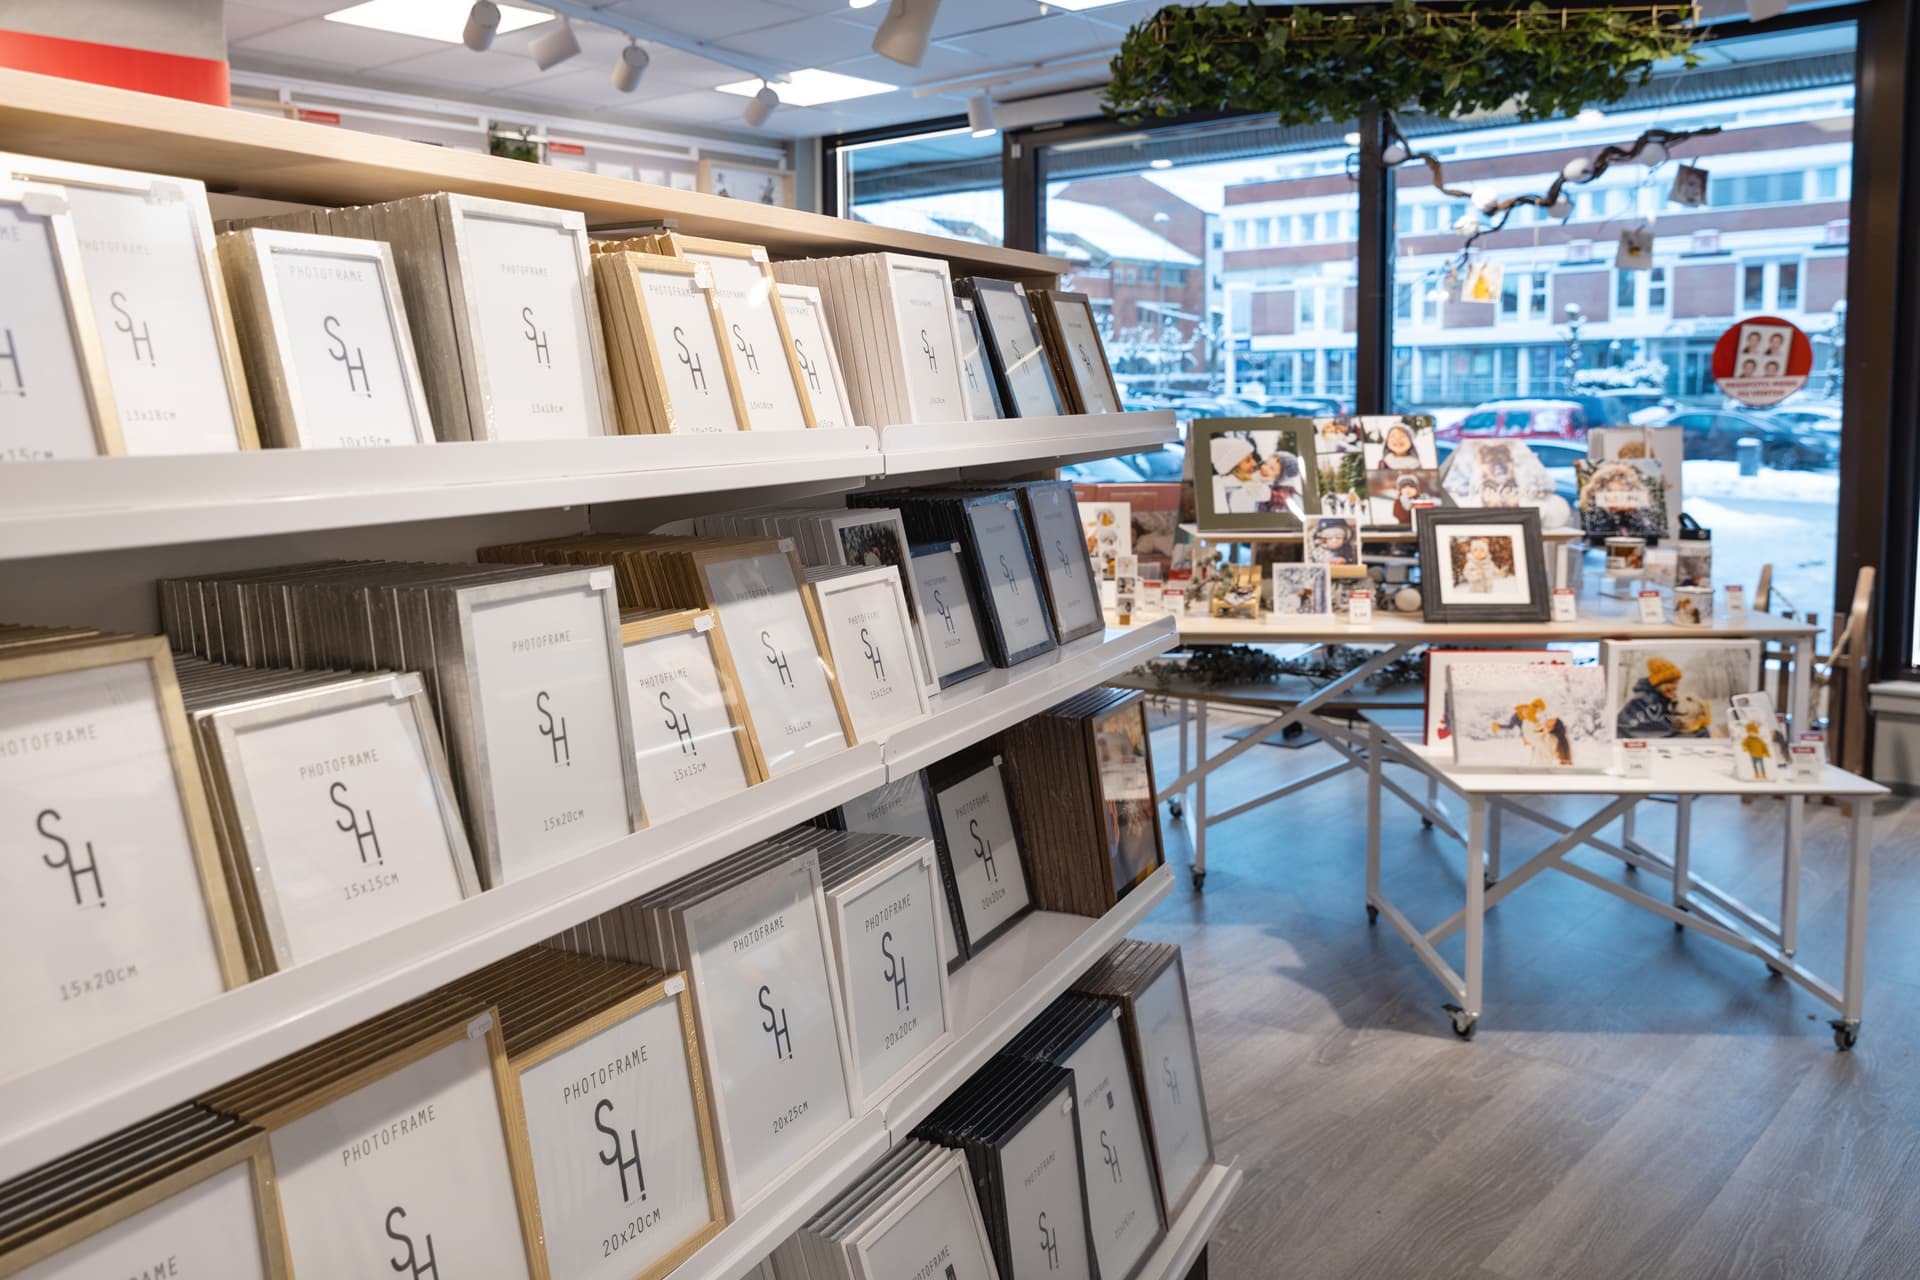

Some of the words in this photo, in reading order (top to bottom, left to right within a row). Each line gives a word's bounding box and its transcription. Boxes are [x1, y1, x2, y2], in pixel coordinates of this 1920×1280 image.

[289, 265, 365, 282] PHOTOFRAME
[512, 630, 572, 653] PHOTOFRAME
[640, 668, 689, 690] PHOTOFRAME
[0, 724, 97, 758] HOTOFRAME
[300, 749, 380, 780] PHOTOFRAME
[867, 797, 903, 822] PHOTOFRAME
[955, 791, 990, 817] PHOTOFRAME
[865, 894, 912, 933] PHOTOFRAME
[733, 915, 786, 953] PHOTOFRAME
[563, 1045, 649, 1105] PHOTOFRAME
[342, 1104, 437, 1167] PHOTOFRAME
